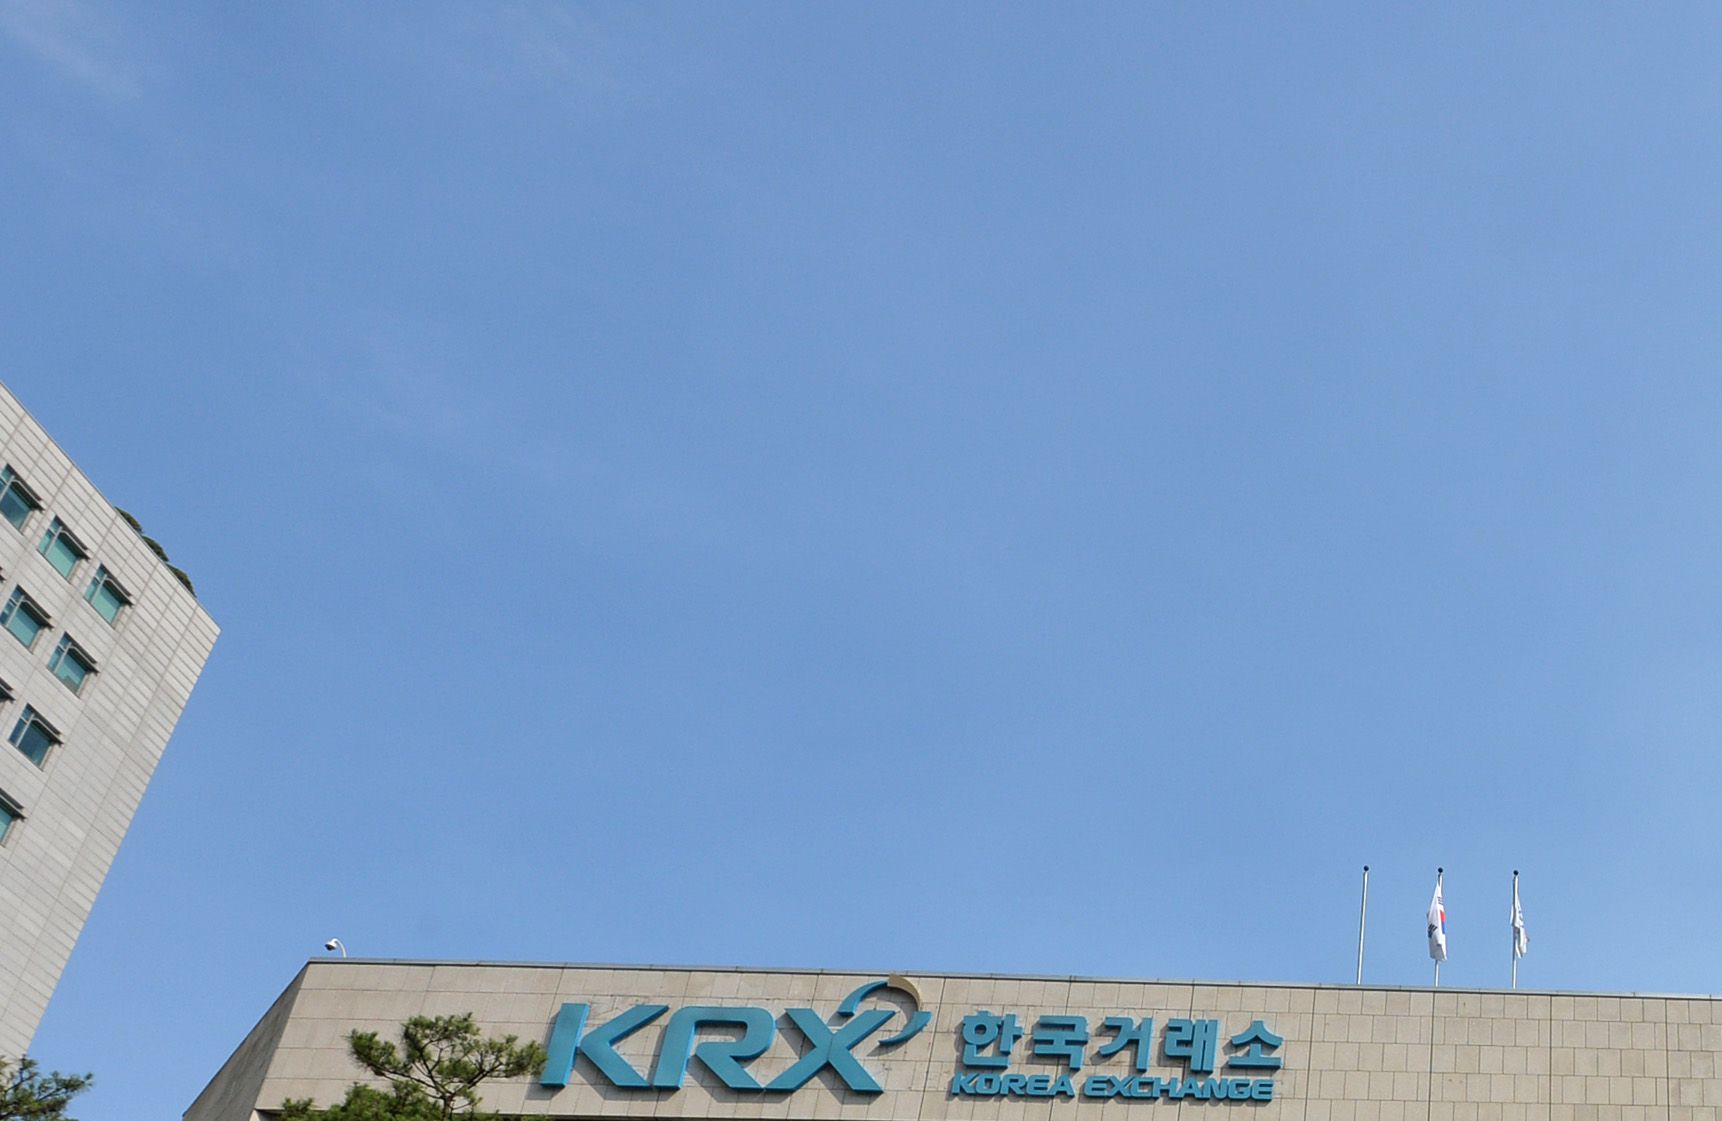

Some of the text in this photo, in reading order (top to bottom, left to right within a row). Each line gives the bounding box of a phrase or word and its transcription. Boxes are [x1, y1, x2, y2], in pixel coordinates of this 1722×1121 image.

[540, 1001, 884, 1094] KRX
[962, 1010, 1284, 1072] 한국거래소
[952, 1073, 1275, 1100] KOREA EXCHANGE
